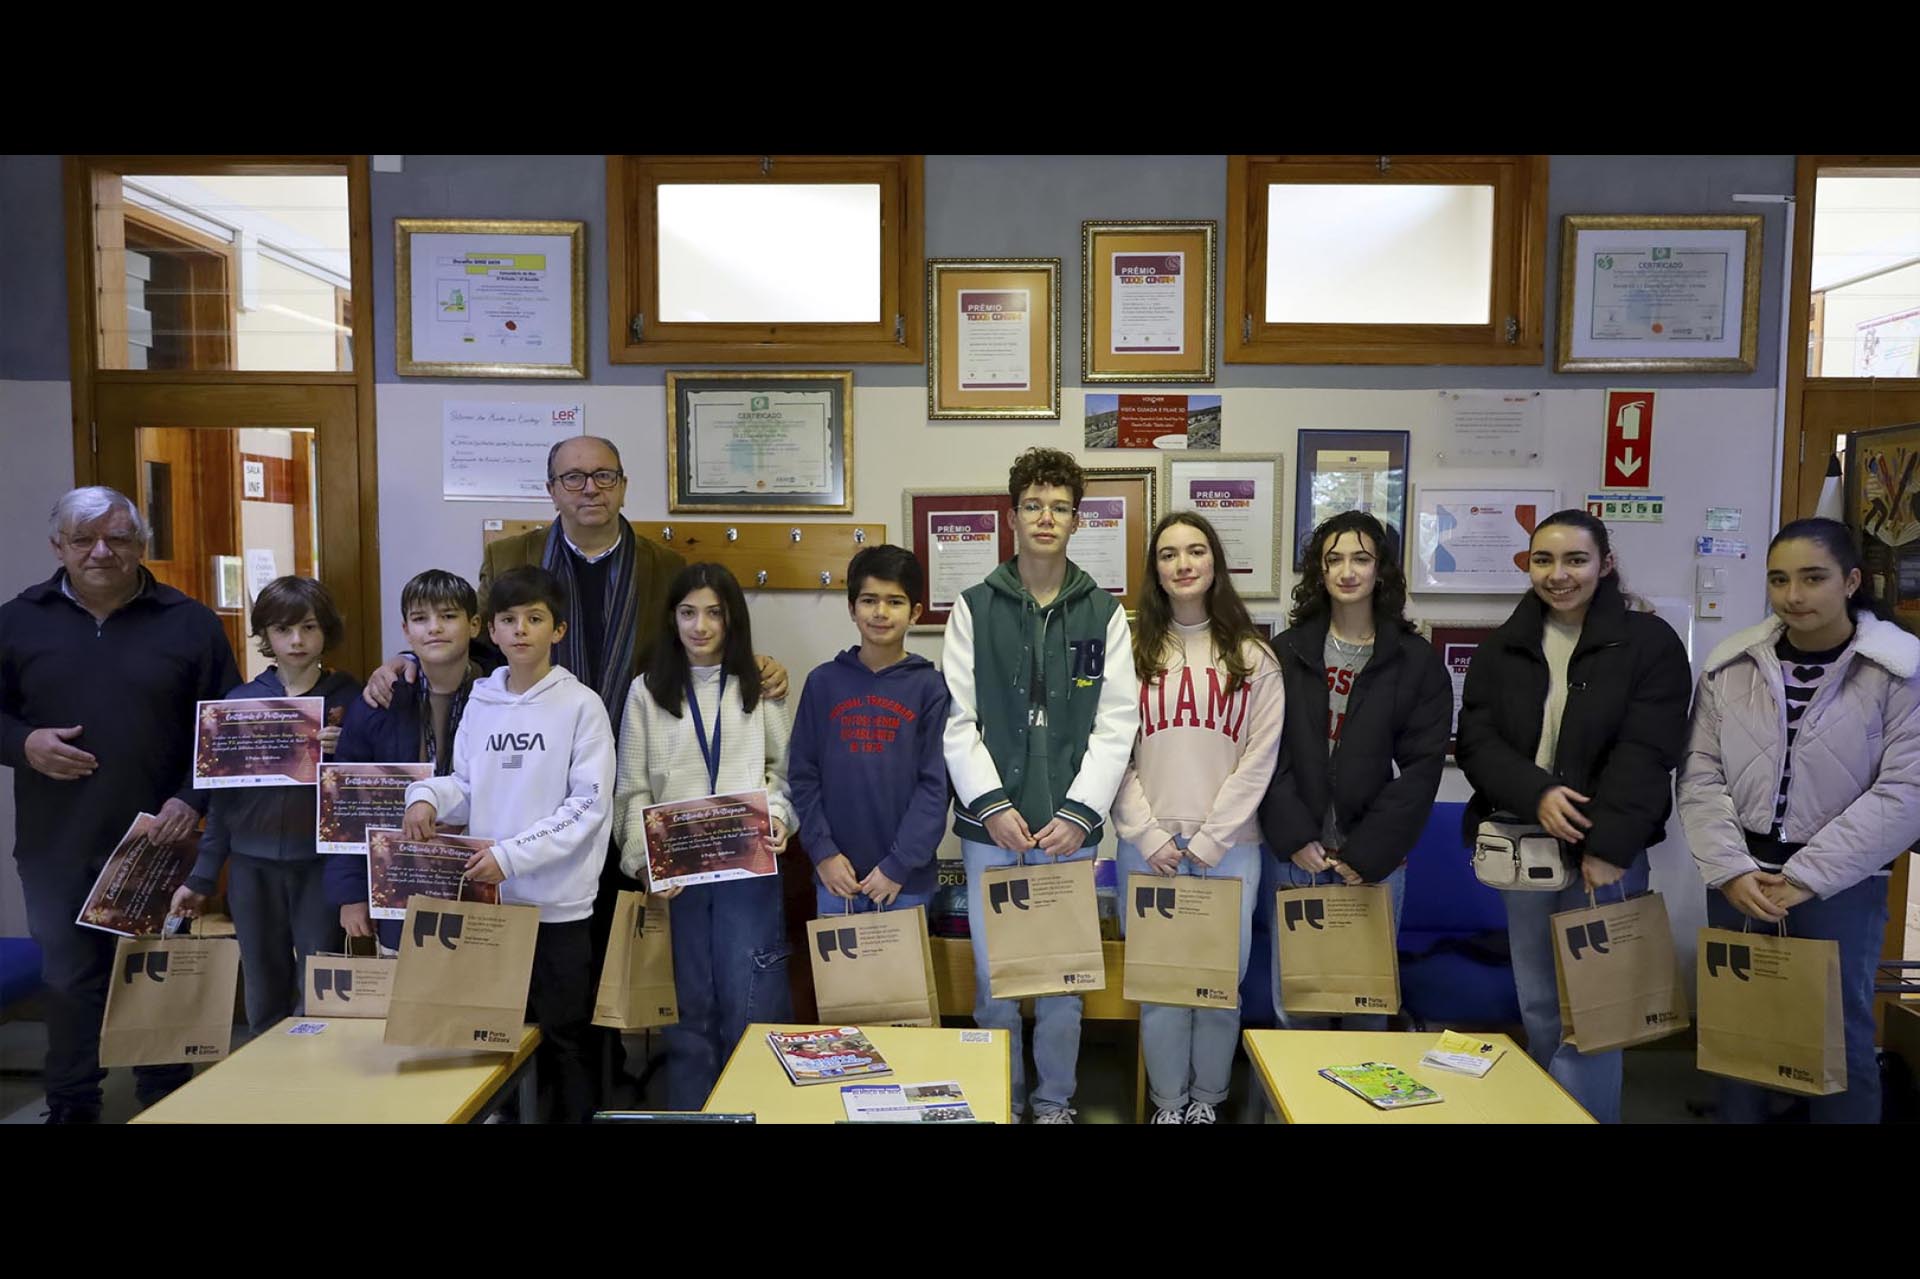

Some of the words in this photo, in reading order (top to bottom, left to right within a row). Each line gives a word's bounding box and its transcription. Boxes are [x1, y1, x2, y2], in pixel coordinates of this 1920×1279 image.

[1121, 265, 1156, 275] PRÉMIO
[1638, 262, 1683, 270] CERTIFICADO
[1120, 276, 1144, 284] TODOS
[1145, 276, 1176, 284] CONTAM
[967, 302, 1003, 312] PRÉMIO
[966, 313, 990, 321] TODOS
[992, 312, 1022, 321] CONTAM
[737, 412, 783, 420] CERTIFICADO
[1196, 490, 1231, 499] PRÉMIO
[1195, 499, 1219, 508] TODOS
[1220, 499, 1250, 508] CONTAM
[1078, 511, 1100, 519] ÉMIO
[1089, 519, 1119, 528] CONTAM
[937, 525, 972, 533] PRÉMIO
[936, 534, 960, 542] TODOS
[961, 534, 992, 542] CONTAM
[1070, 639, 1105, 680] 78
[1454, 656, 1472, 664] PRÉ
[1028, 705, 1048, 727] FA
[485, 732, 546, 751] NASA
[488, 1036, 510, 1044] Editora
[772, 1033, 833, 1043] VISÃO
